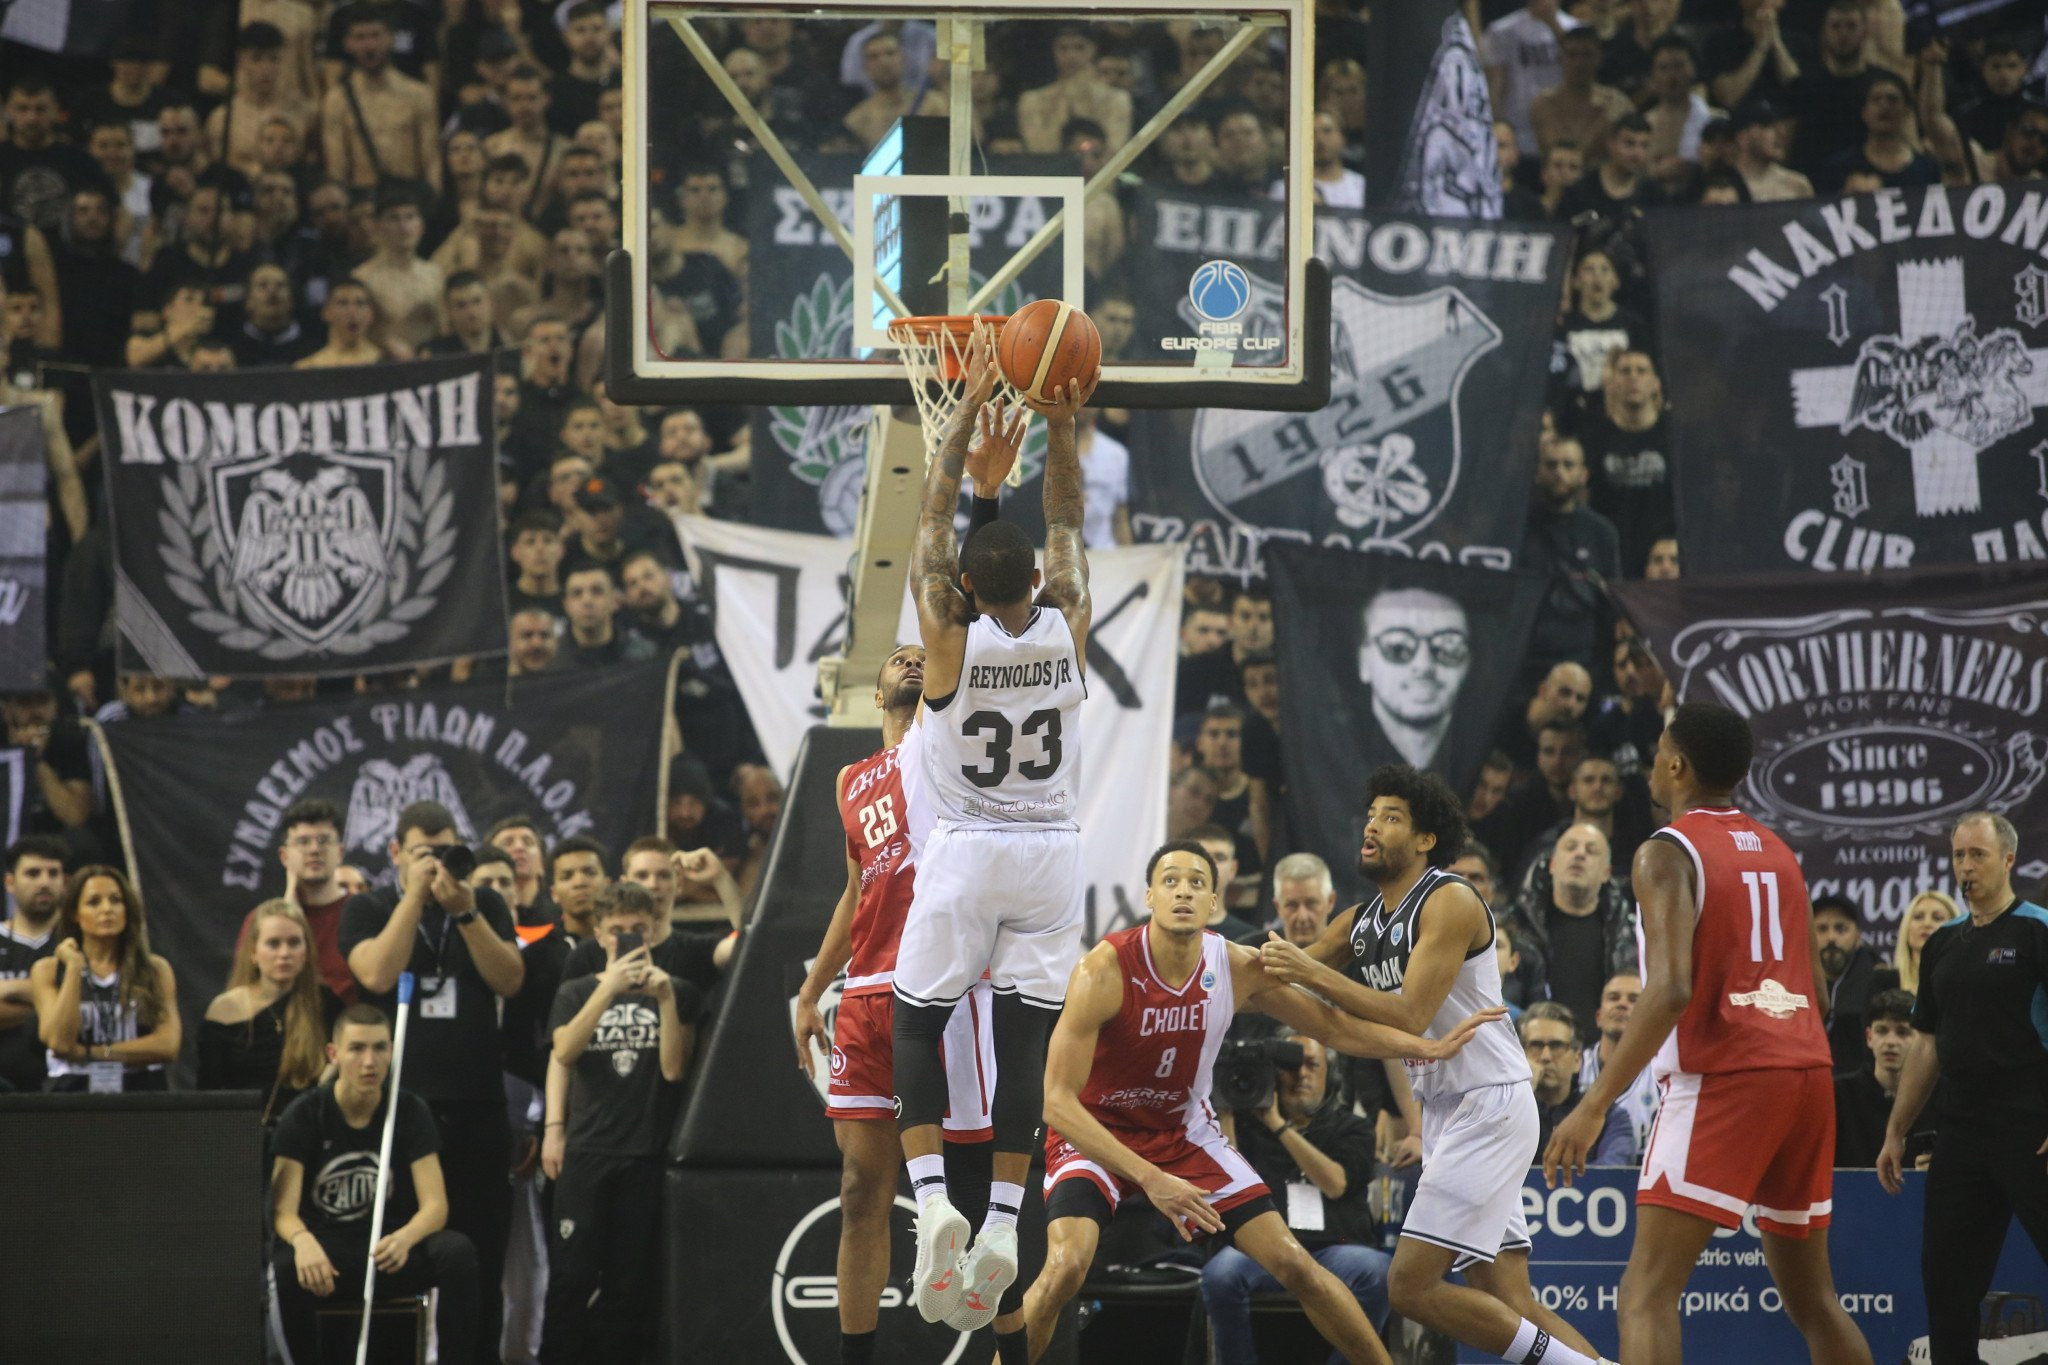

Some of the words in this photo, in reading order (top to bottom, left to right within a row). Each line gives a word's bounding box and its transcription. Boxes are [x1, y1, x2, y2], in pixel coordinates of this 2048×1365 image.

[1728, 184, 2048, 312] ΜΑΚΕΔΟΝ
[1161, 337, 1237, 350] EUROPE
[1243, 337, 1280, 350] CUP
[1199, 322, 1242, 335] FIBA
[110, 373, 482, 465] ΚΟΜΟΤΗΝΗ
[1228, 366, 1425, 486] 1926
[969, 661, 1052, 689] REYNOLDS
[1055, 658, 1072, 690] JR
[1706, 629, 2048, 718] NORTHERNERS
[1886, 695, 1952, 716] FANS
[961, 708, 1062, 788] 33
[1827, 738, 1928, 772] Since
[1820, 777, 1943, 810] 1996
[858, 793, 898, 849] 25
[1834, 844, 1927, 865] ALCOHOL
[1741, 872, 1783, 962] 11
[1140, 999, 1212, 1037] CHOLET
[1155, 1047, 1176, 1078] 8
